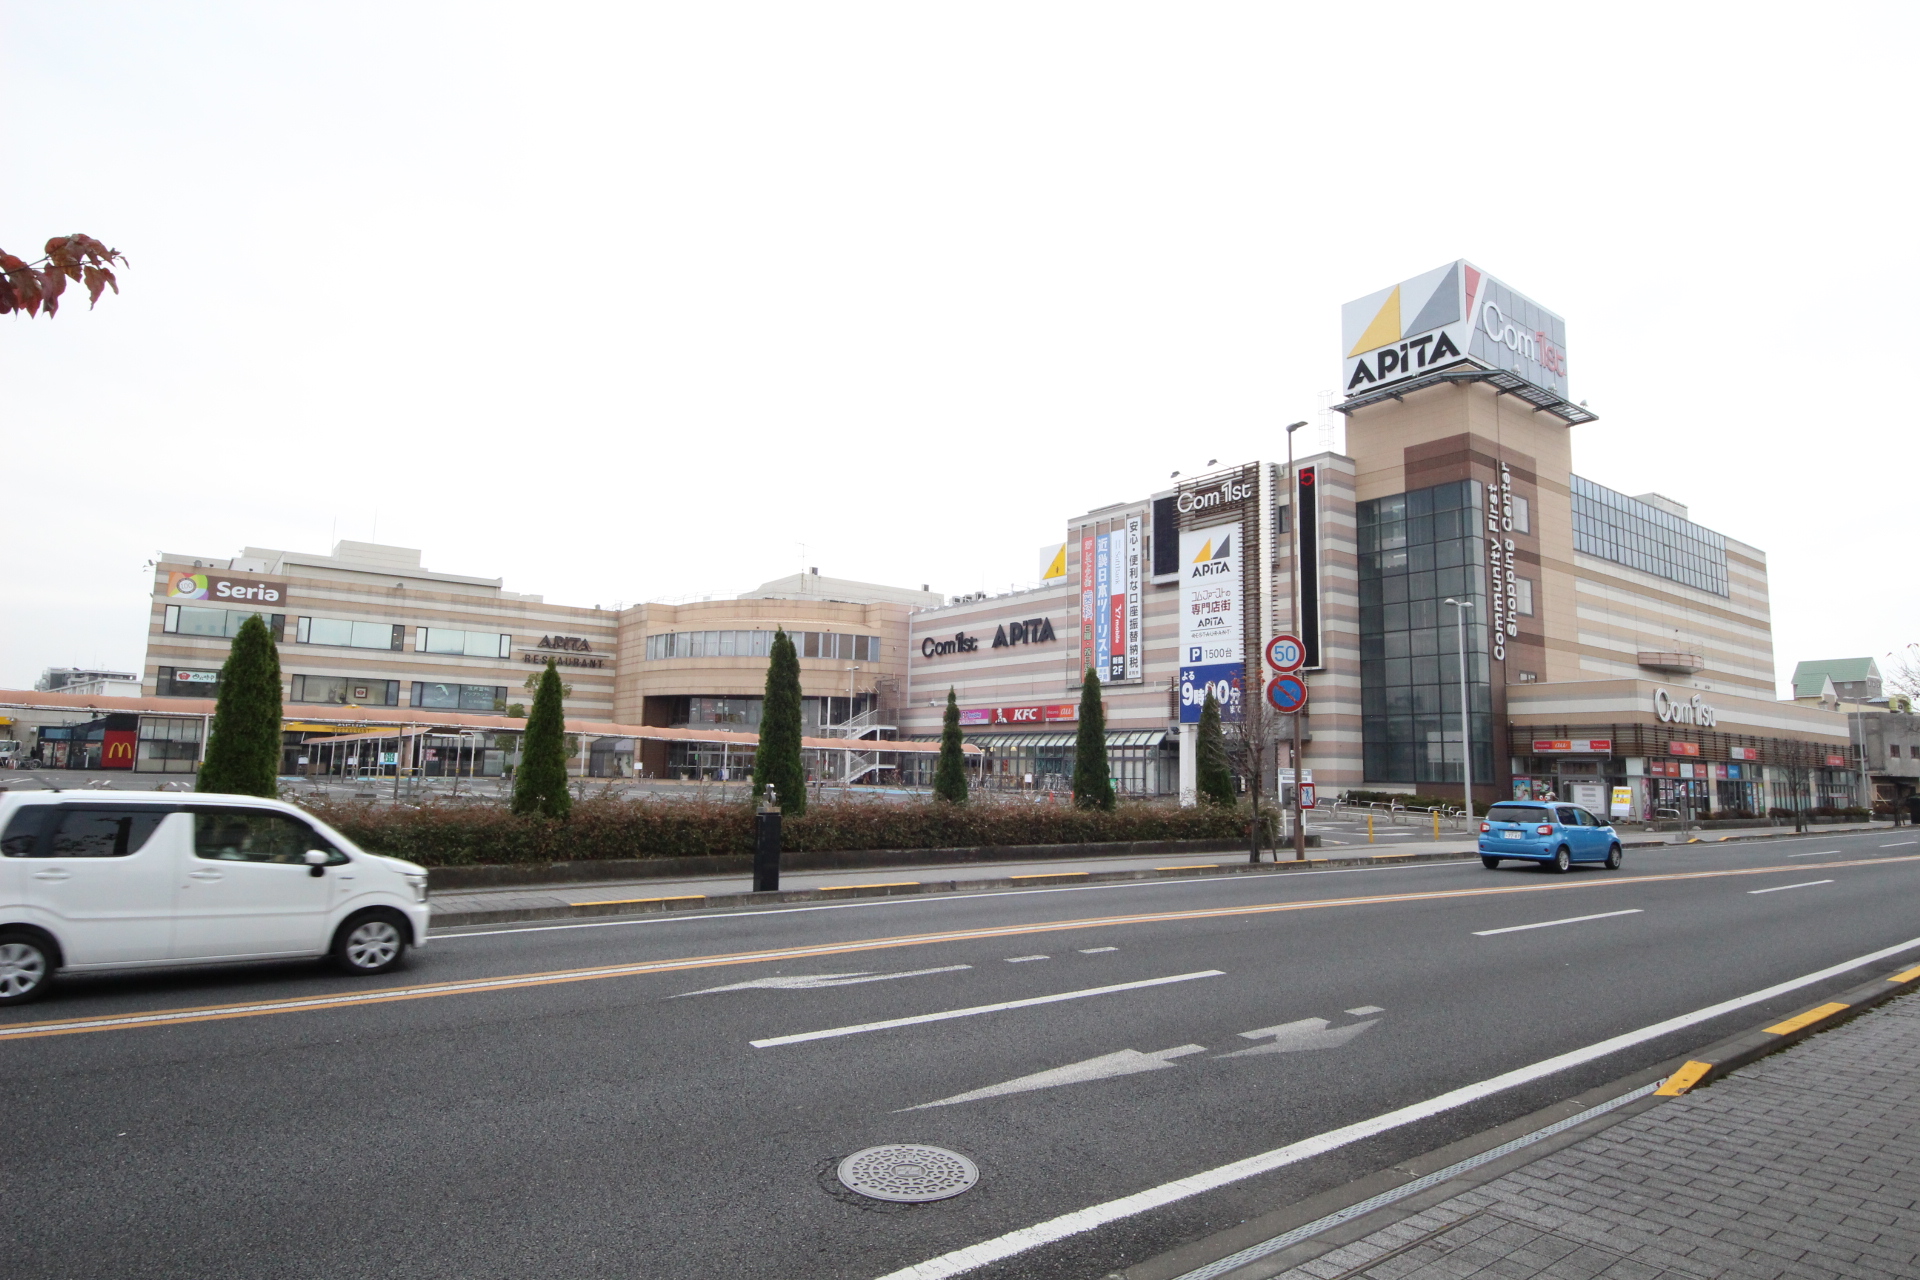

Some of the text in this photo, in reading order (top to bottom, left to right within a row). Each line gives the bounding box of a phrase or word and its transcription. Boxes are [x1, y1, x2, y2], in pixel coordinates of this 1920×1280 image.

[1501, 461, 1517, 637] Shopping Center
[1487, 484, 1505, 660] Community First
[216, 581, 279, 602] Seria
[1191, 599, 1231, 615] 専門店街
[522, 654, 604, 668] RESAURANT
[1205, 648, 1232, 659] 1500台
[1274, 645, 1297, 662] 50
[1112, 665, 1124, 675] 2F
[1181, 671, 1196, 681] よる
[1013, 708, 1038, 721] KFC
